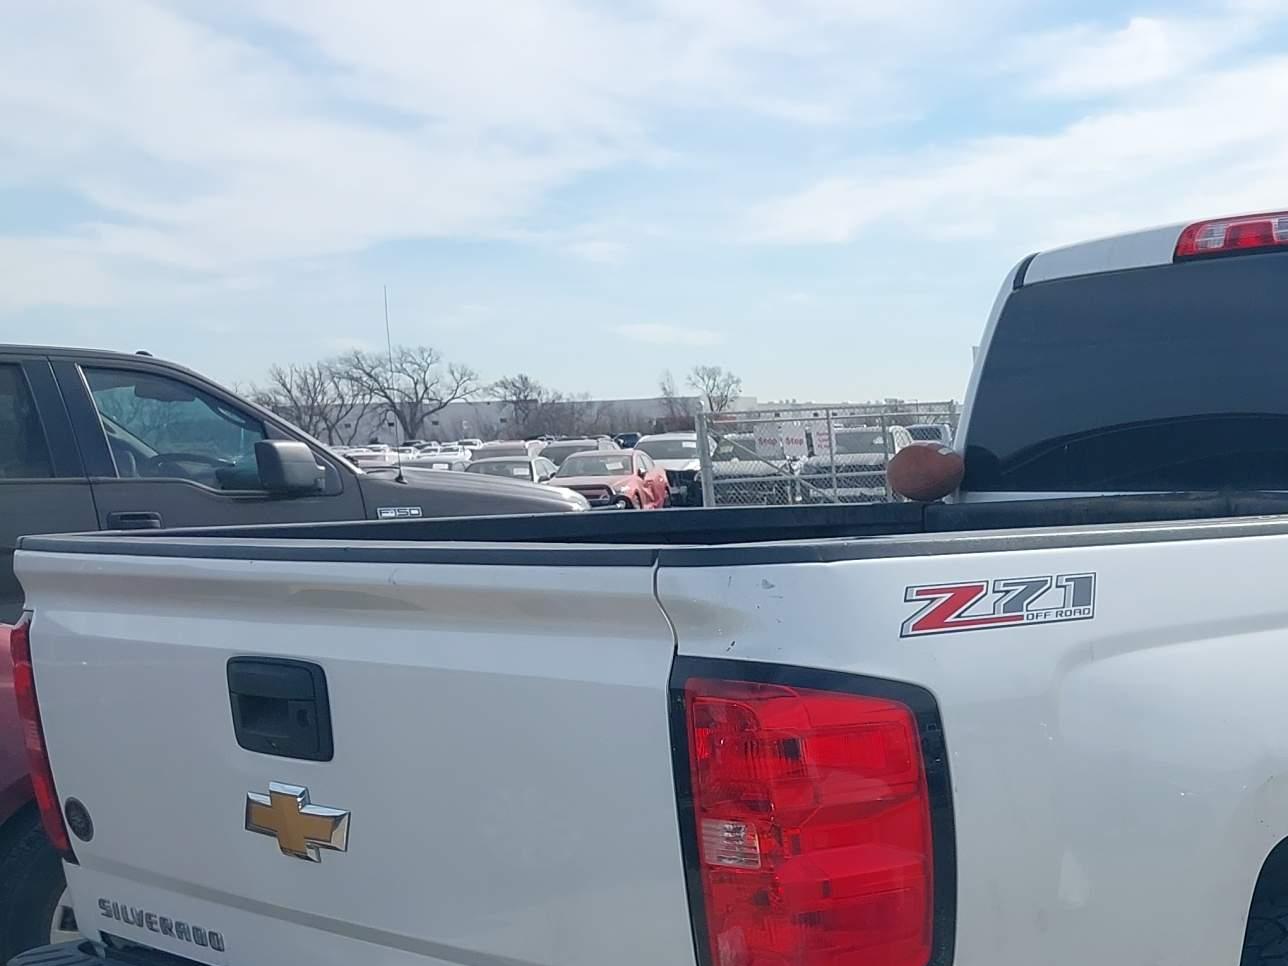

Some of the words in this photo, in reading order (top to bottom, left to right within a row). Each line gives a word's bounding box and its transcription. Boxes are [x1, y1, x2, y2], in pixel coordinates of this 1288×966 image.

[900, 572, 1096, 638] Z71
[1026, 612, 1051, 621] OFF
[1055, 607, 1091, 619] ROAD
[98, 898, 226, 953] SILVERADO
